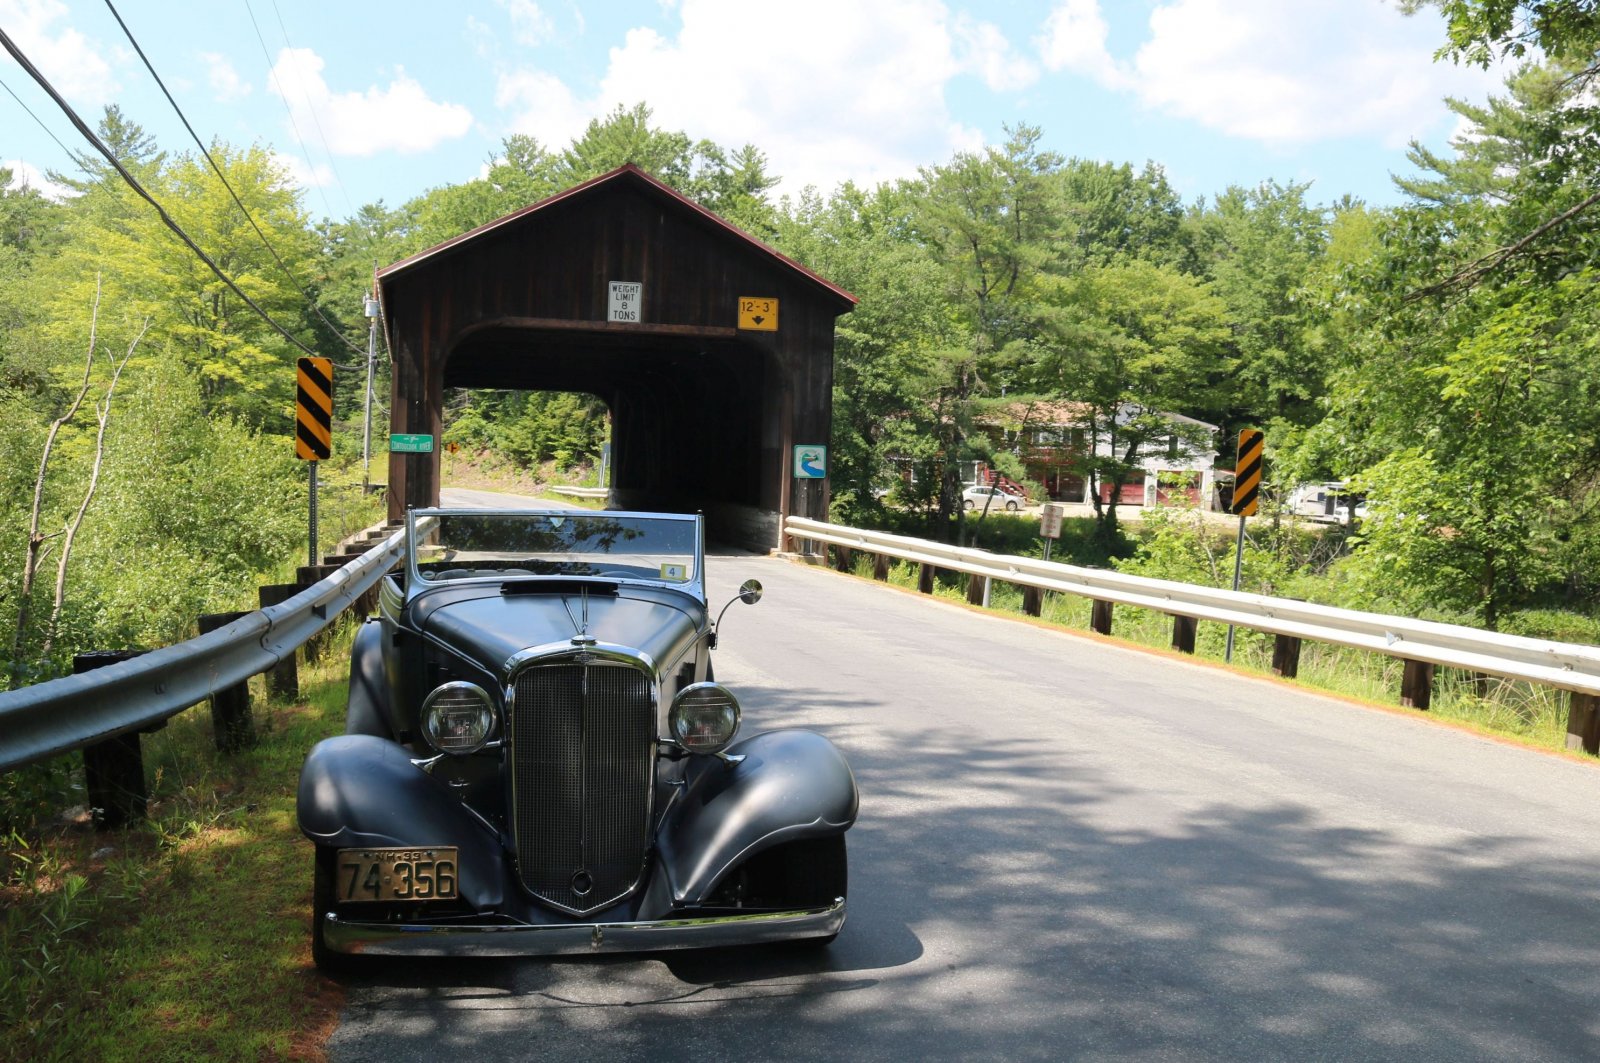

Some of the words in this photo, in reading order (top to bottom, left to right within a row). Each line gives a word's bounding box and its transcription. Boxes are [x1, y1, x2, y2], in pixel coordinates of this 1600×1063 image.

[612, 284, 640, 294] WEIGHT
[615, 293, 635, 302] LIMIT
[621, 302, 628, 310] 8
[613, 310, 636, 321] TONS
[668, 567, 676, 577] 4
